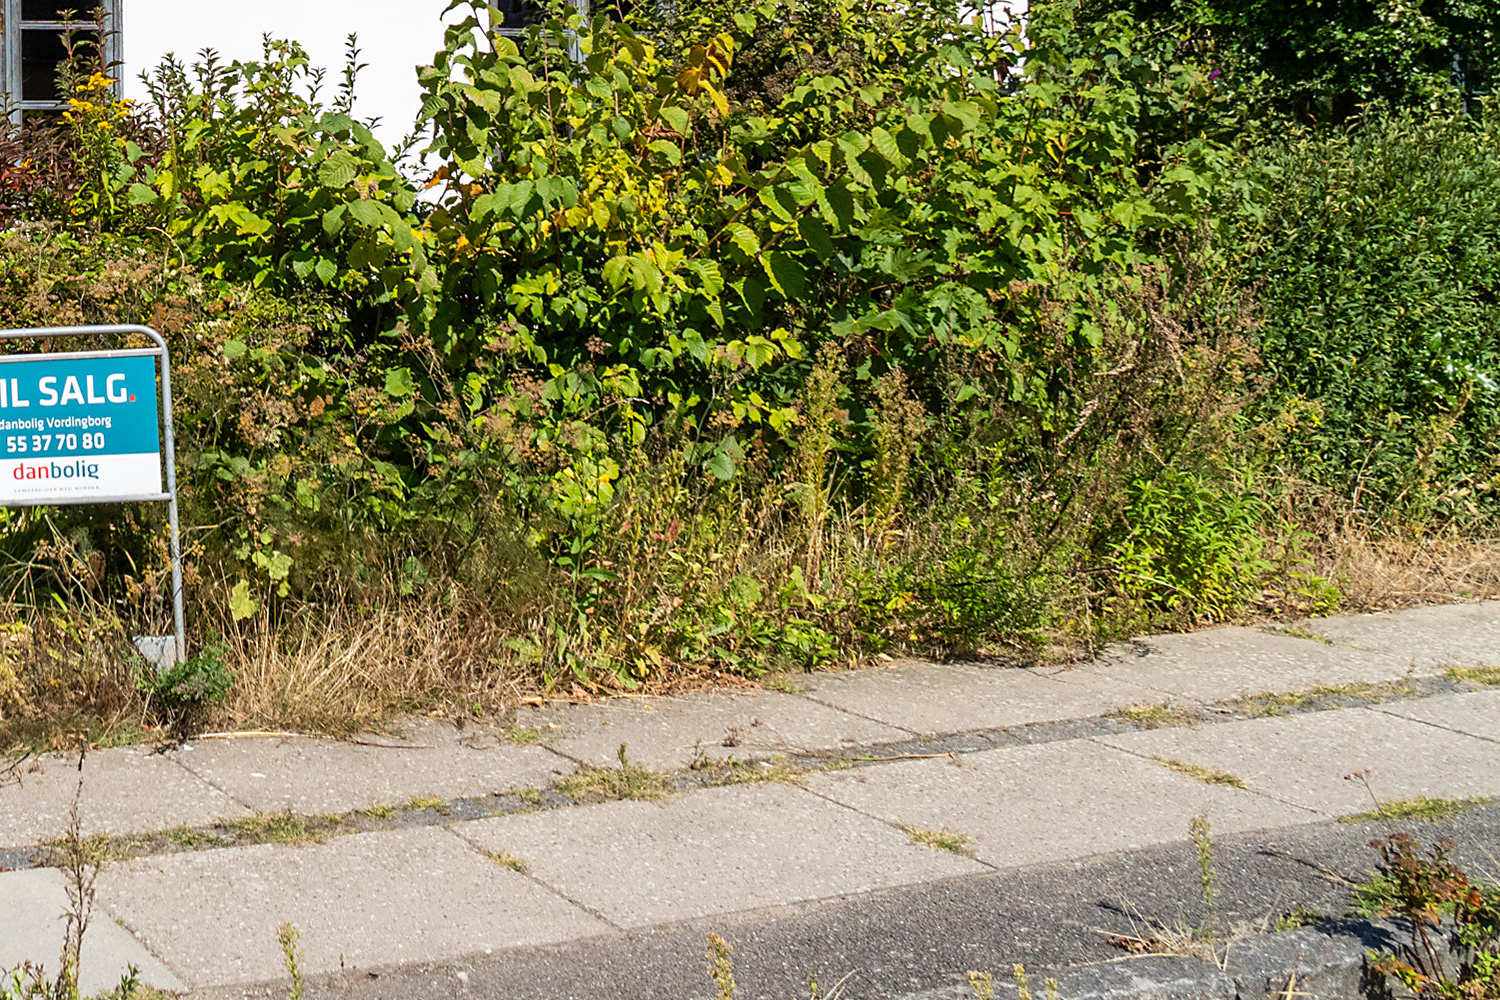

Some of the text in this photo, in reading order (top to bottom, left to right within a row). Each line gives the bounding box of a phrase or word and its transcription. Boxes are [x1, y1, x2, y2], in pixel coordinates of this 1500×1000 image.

[46, 415, 112, 429] Vordingborg
[6, 432, 105, 453] 55 37 70 80
[13, 460, 100, 480] danbolig
